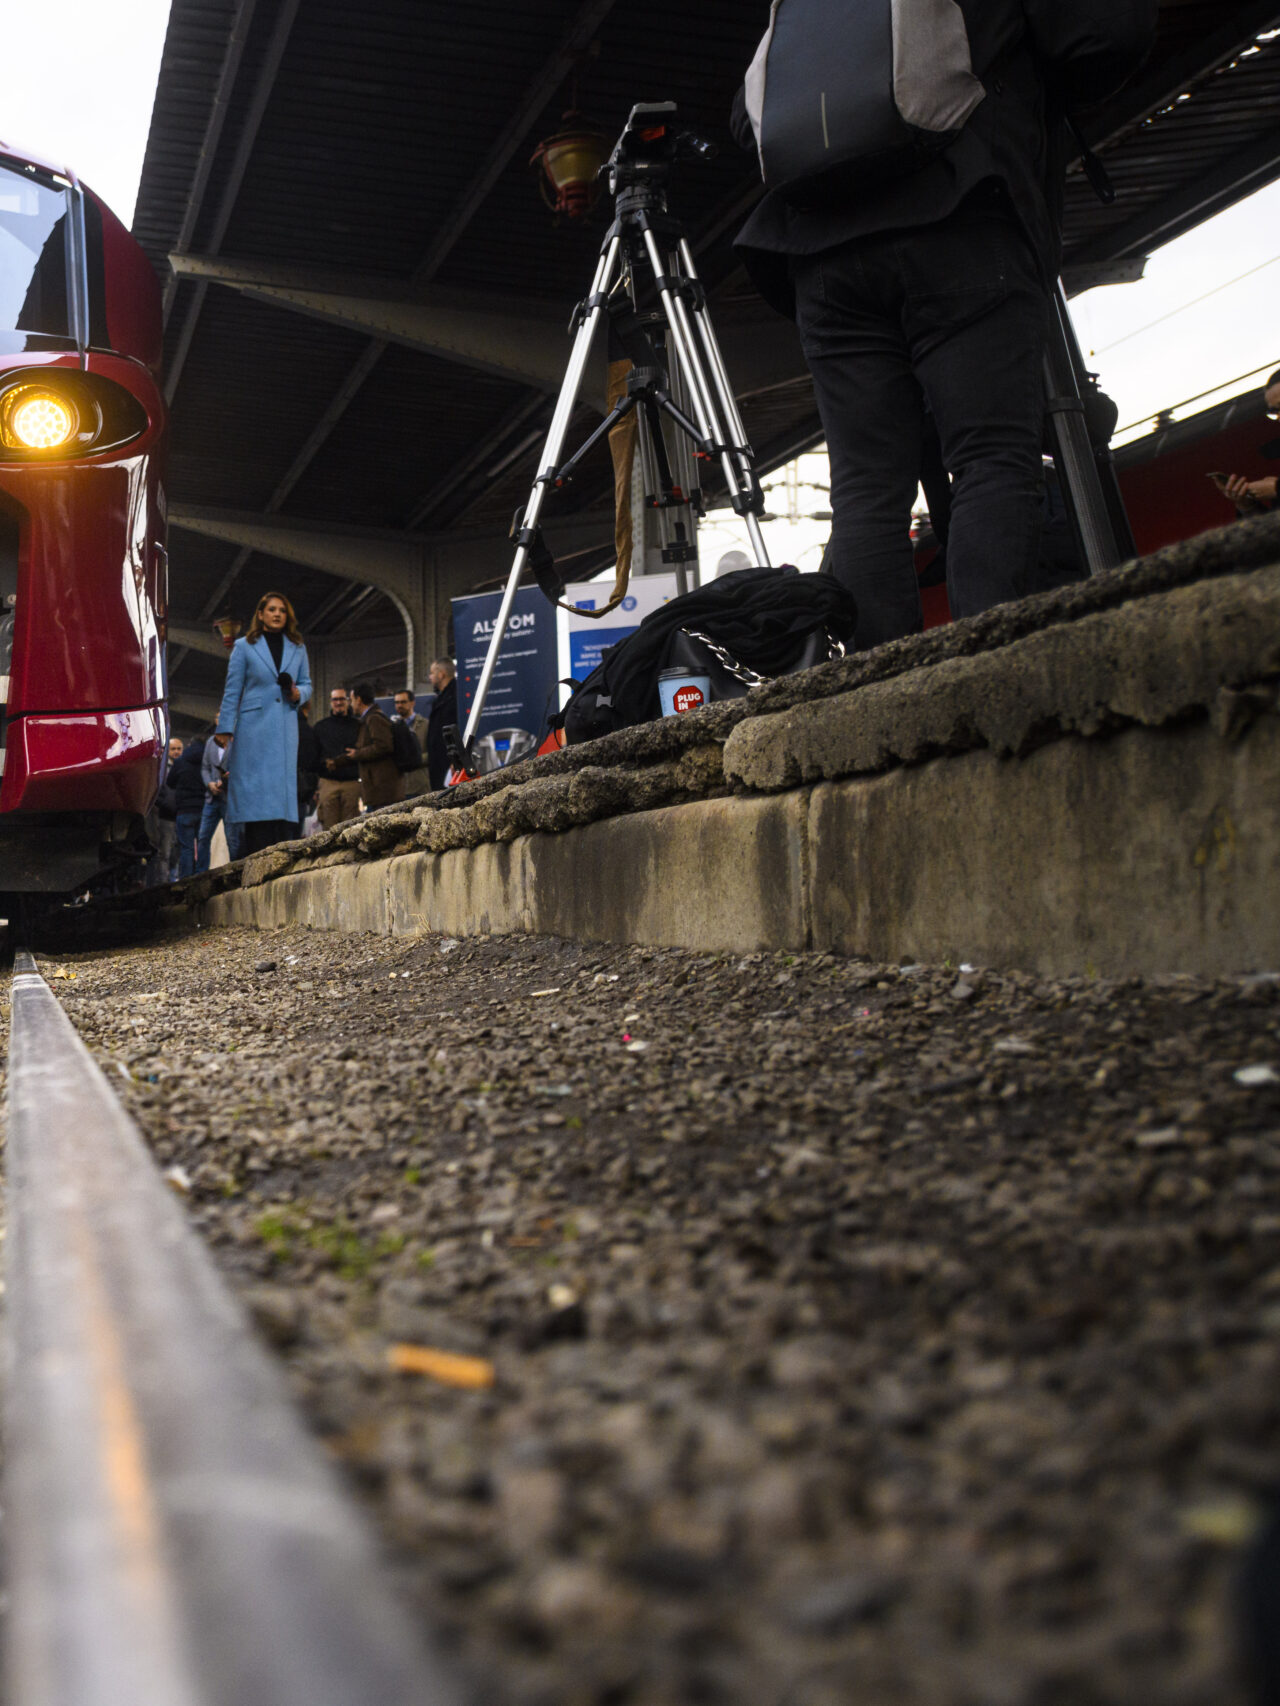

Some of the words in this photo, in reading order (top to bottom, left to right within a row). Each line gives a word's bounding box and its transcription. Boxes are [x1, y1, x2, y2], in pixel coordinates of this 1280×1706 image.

[473, 613, 535, 635] ALOM
[677, 692, 701, 703] PLUG
[678, 702, 689, 710] IN
